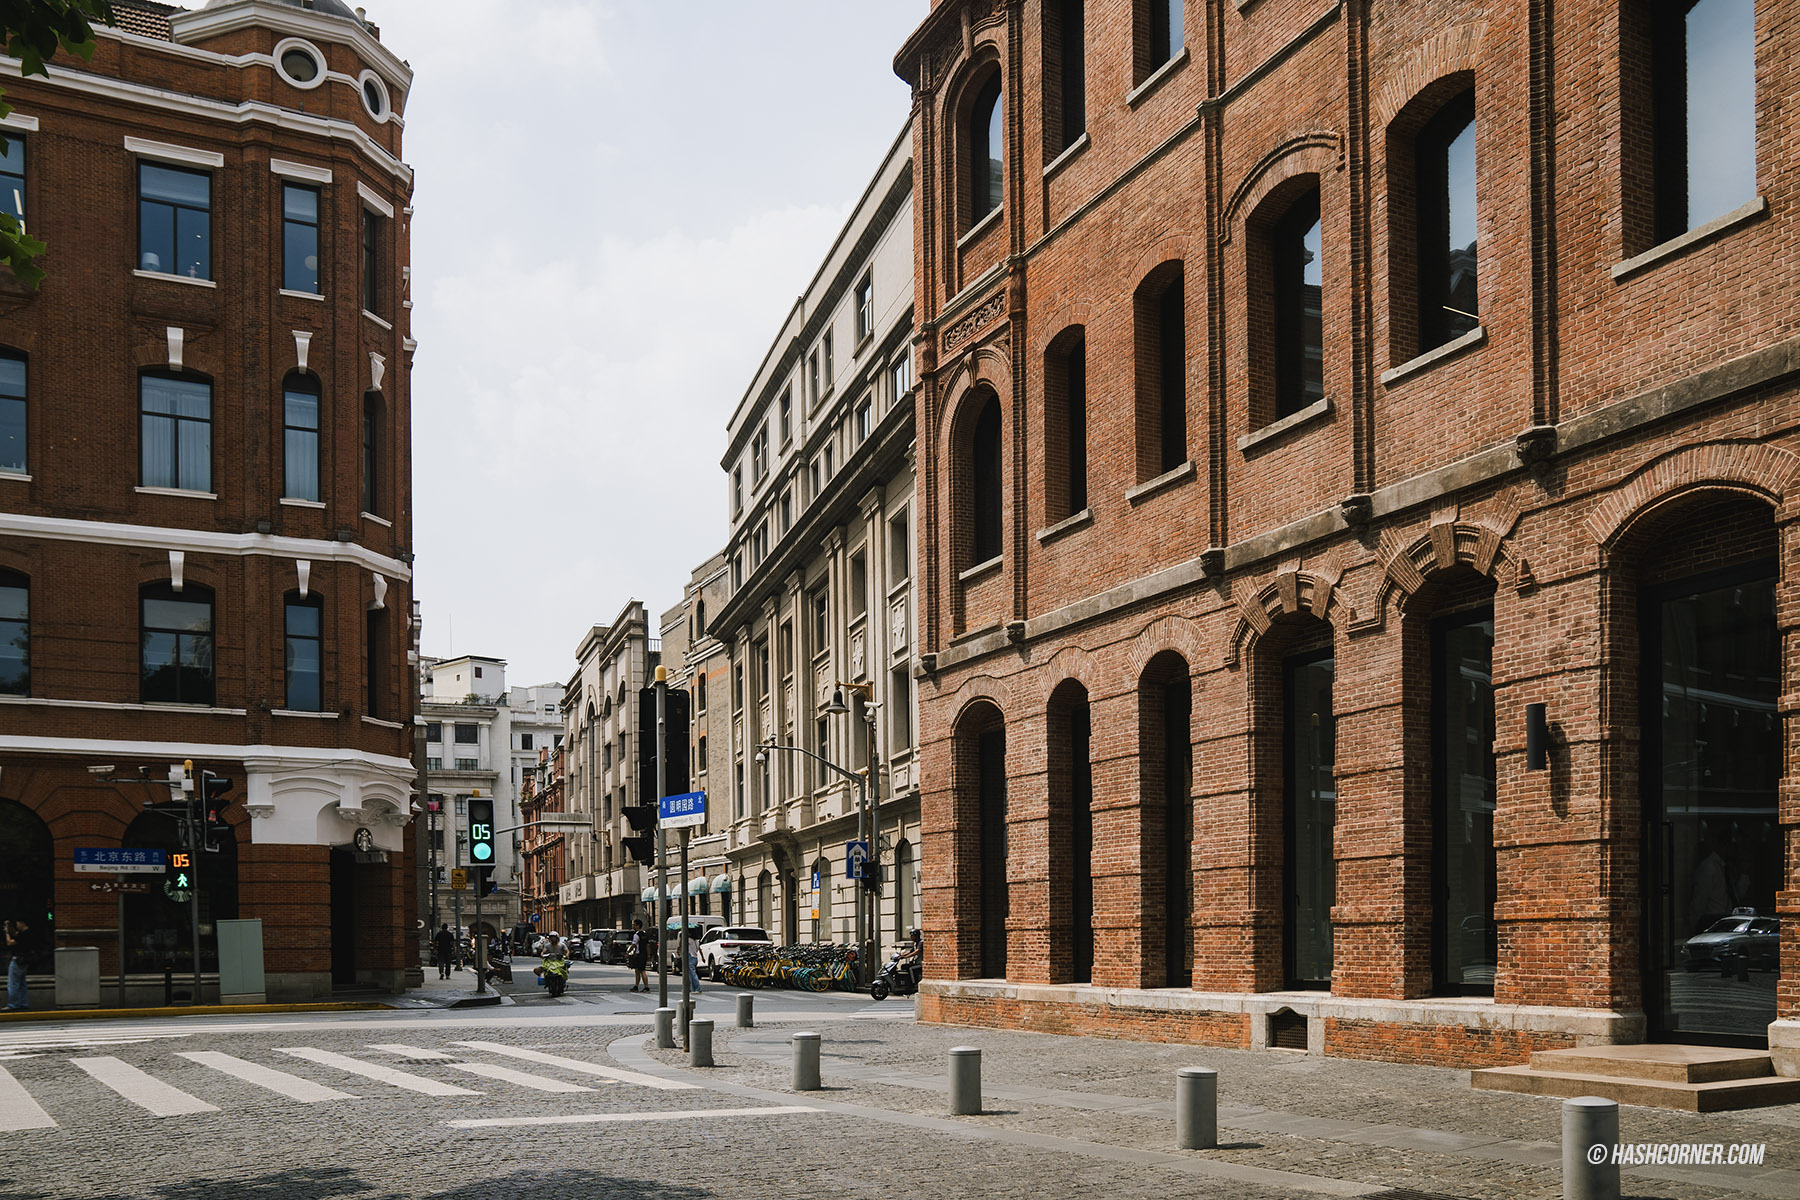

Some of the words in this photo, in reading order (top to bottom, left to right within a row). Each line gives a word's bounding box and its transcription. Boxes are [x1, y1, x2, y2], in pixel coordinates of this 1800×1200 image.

[472, 824, 490, 840] 05
[94, 851, 146, 862] 北京东路
[173, 854, 190, 868] 05
